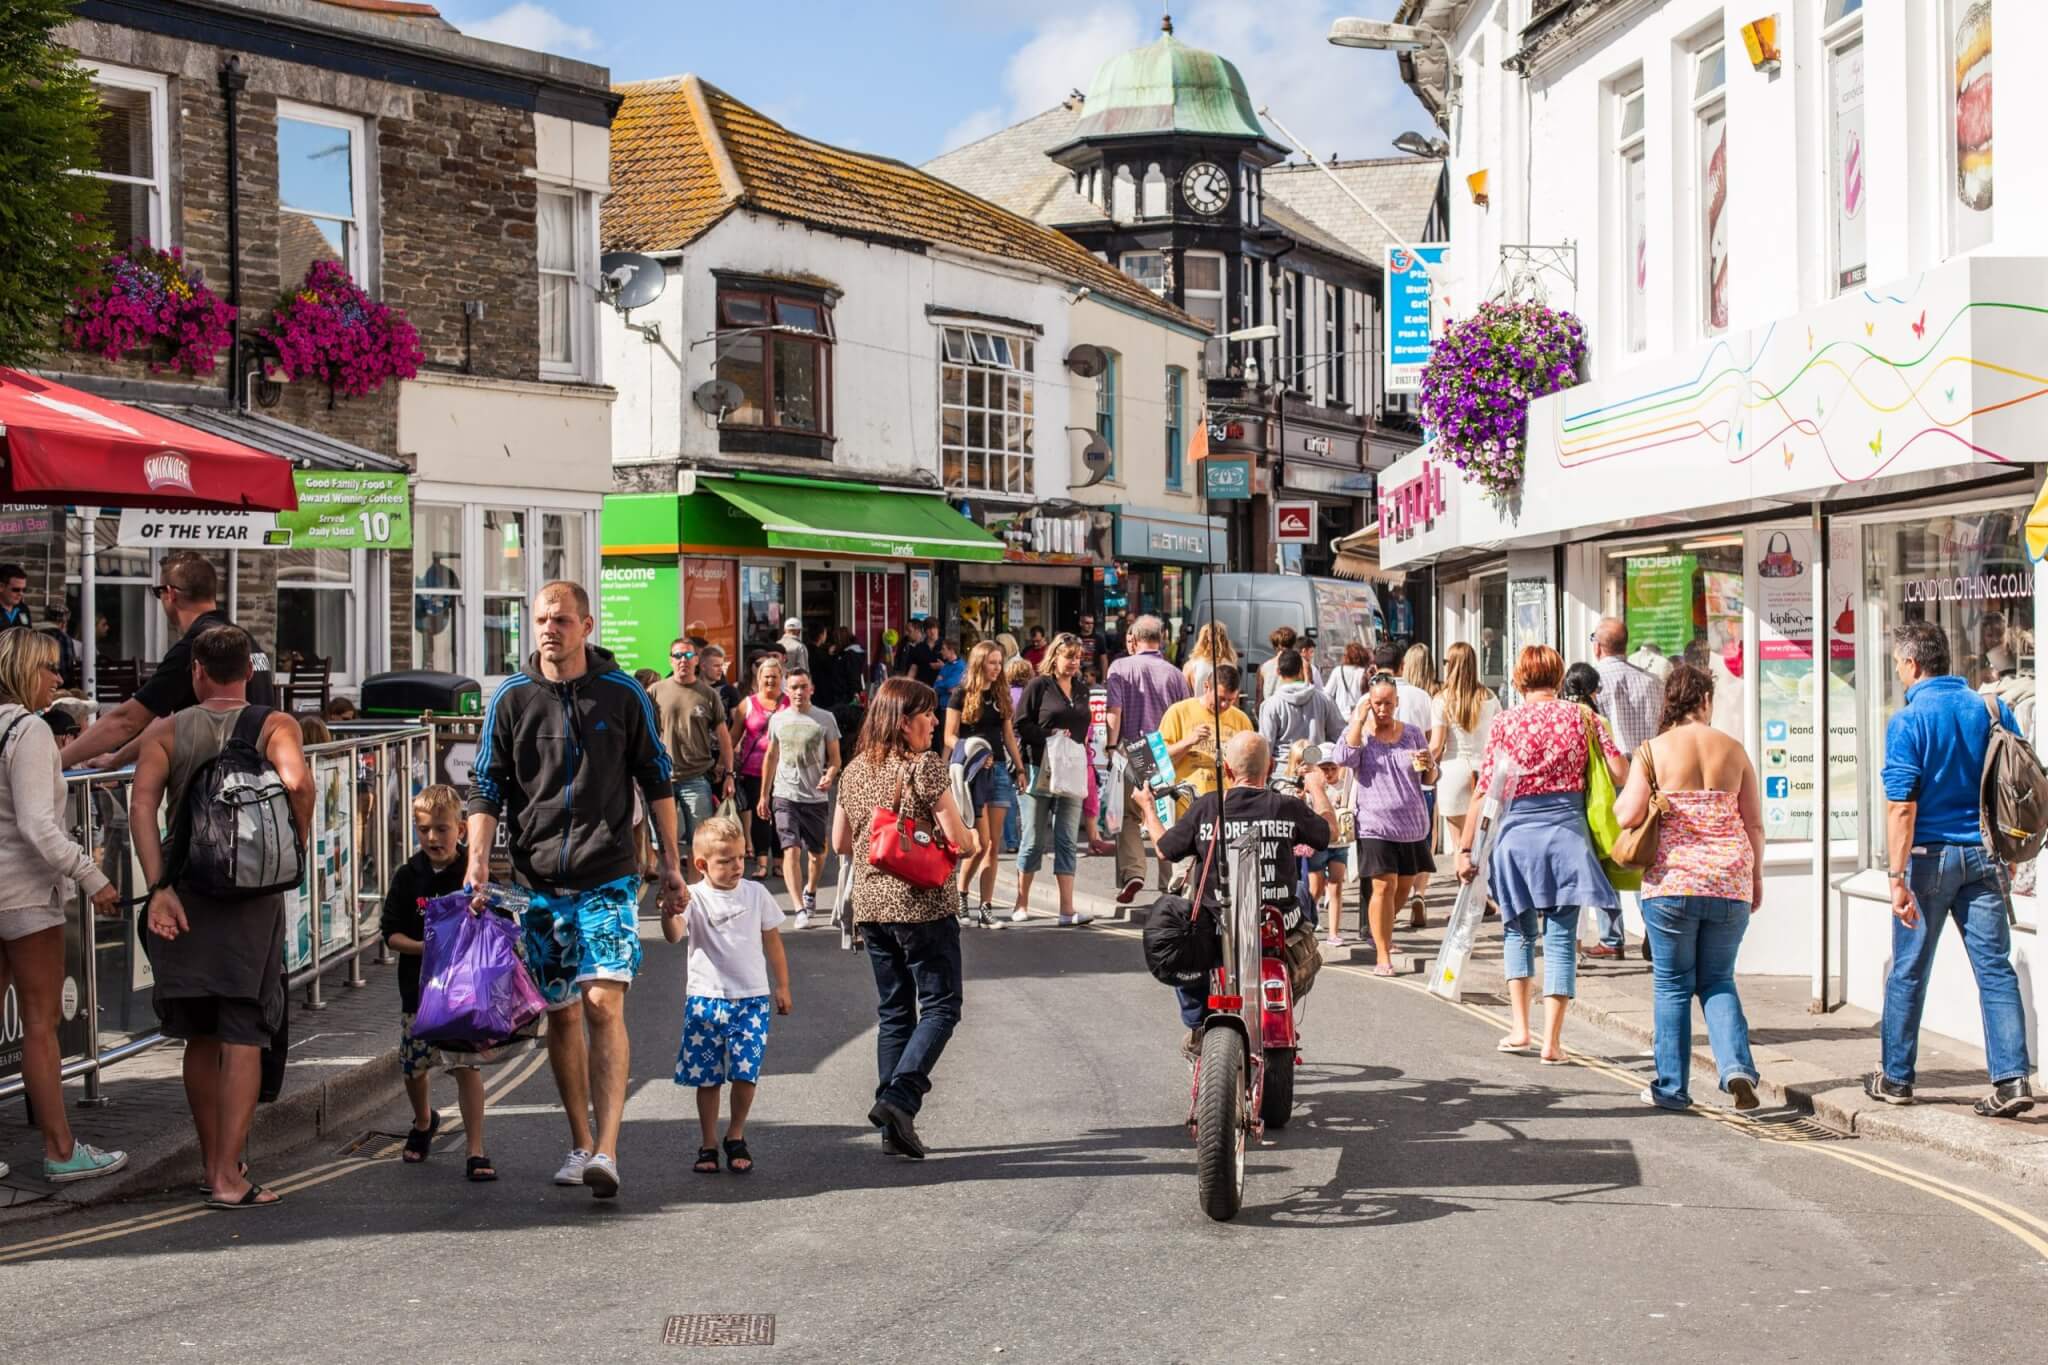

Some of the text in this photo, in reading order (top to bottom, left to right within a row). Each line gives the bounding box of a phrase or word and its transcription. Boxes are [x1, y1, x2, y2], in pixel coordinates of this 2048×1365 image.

[146, 455, 189, 483] SMIRNOFF
[307, 479, 330, 489] Good
[331, 480, 360, 491] Family
[362, 481, 385, 490] Food
[299, 493, 404, 506] Award Winning Coffees
[140, 524, 249, 541] OF THE YEAR
[309, 527, 355, 538] Daily Until
[359, 511, 391, 543] 10
[1200, 823, 1214, 841] 52
